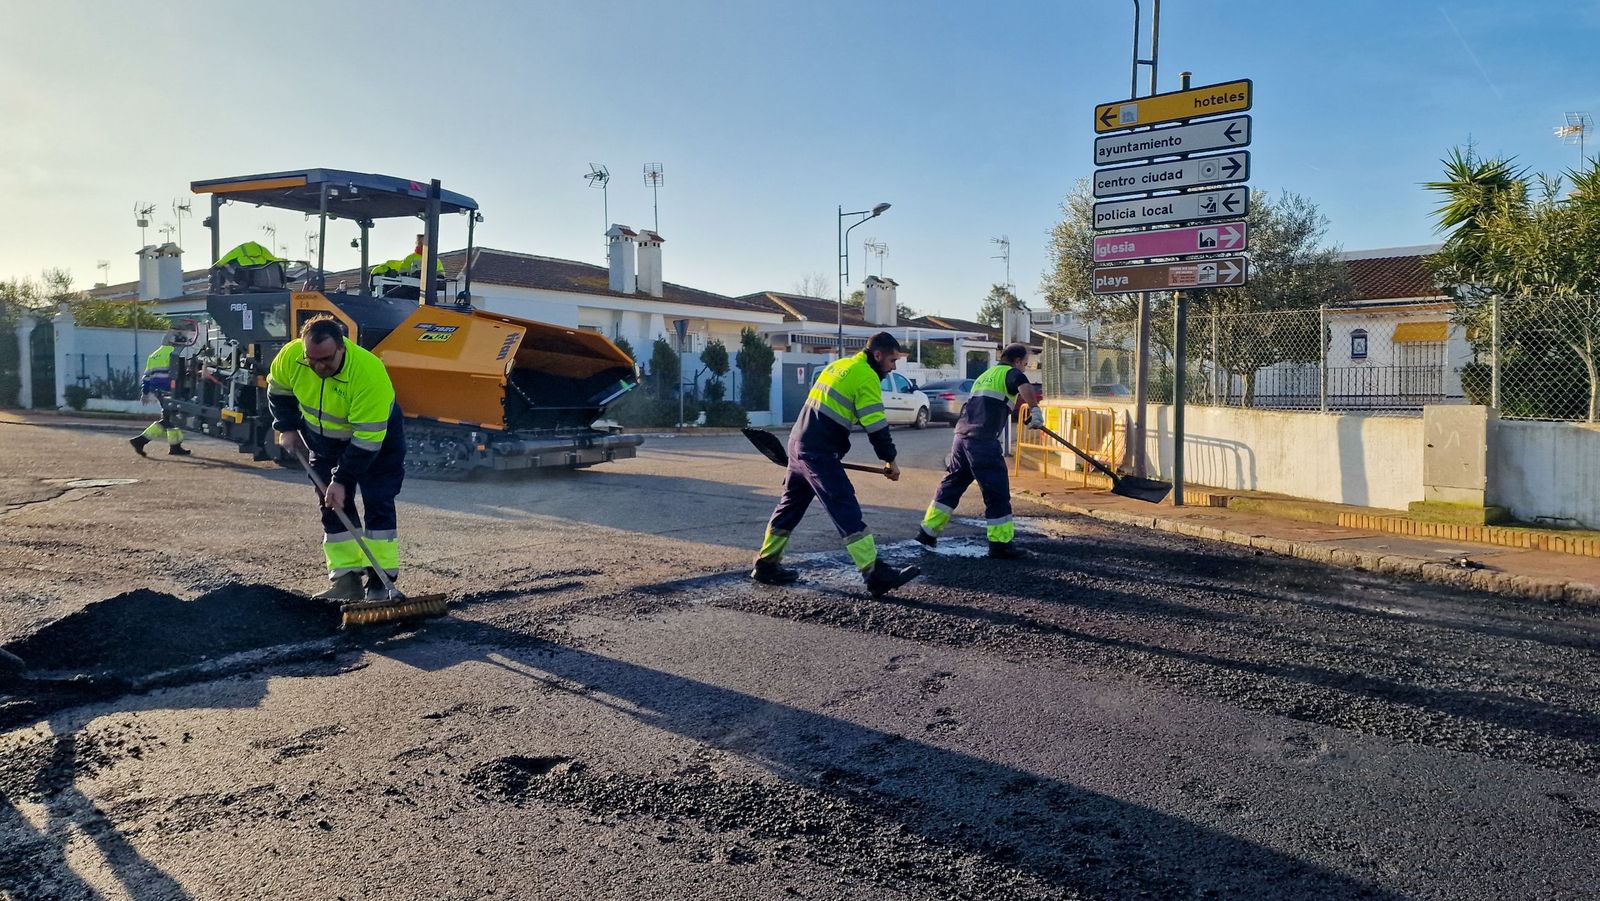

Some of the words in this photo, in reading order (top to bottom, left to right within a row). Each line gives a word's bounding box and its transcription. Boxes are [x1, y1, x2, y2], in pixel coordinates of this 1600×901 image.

[1194, 91, 1245, 108] hoteles
[1098, 135, 1182, 157] ayuntamiento
[1097, 176, 1136, 189] centro
[1141, 169, 1183, 184] ciudad
[1097, 207, 1136, 223] policia
[1142, 203, 1173, 217] local
[1096, 241, 1136, 257] iglesia
[1096, 274, 1129, 289] playa
[230, 303, 248, 311] ABG
